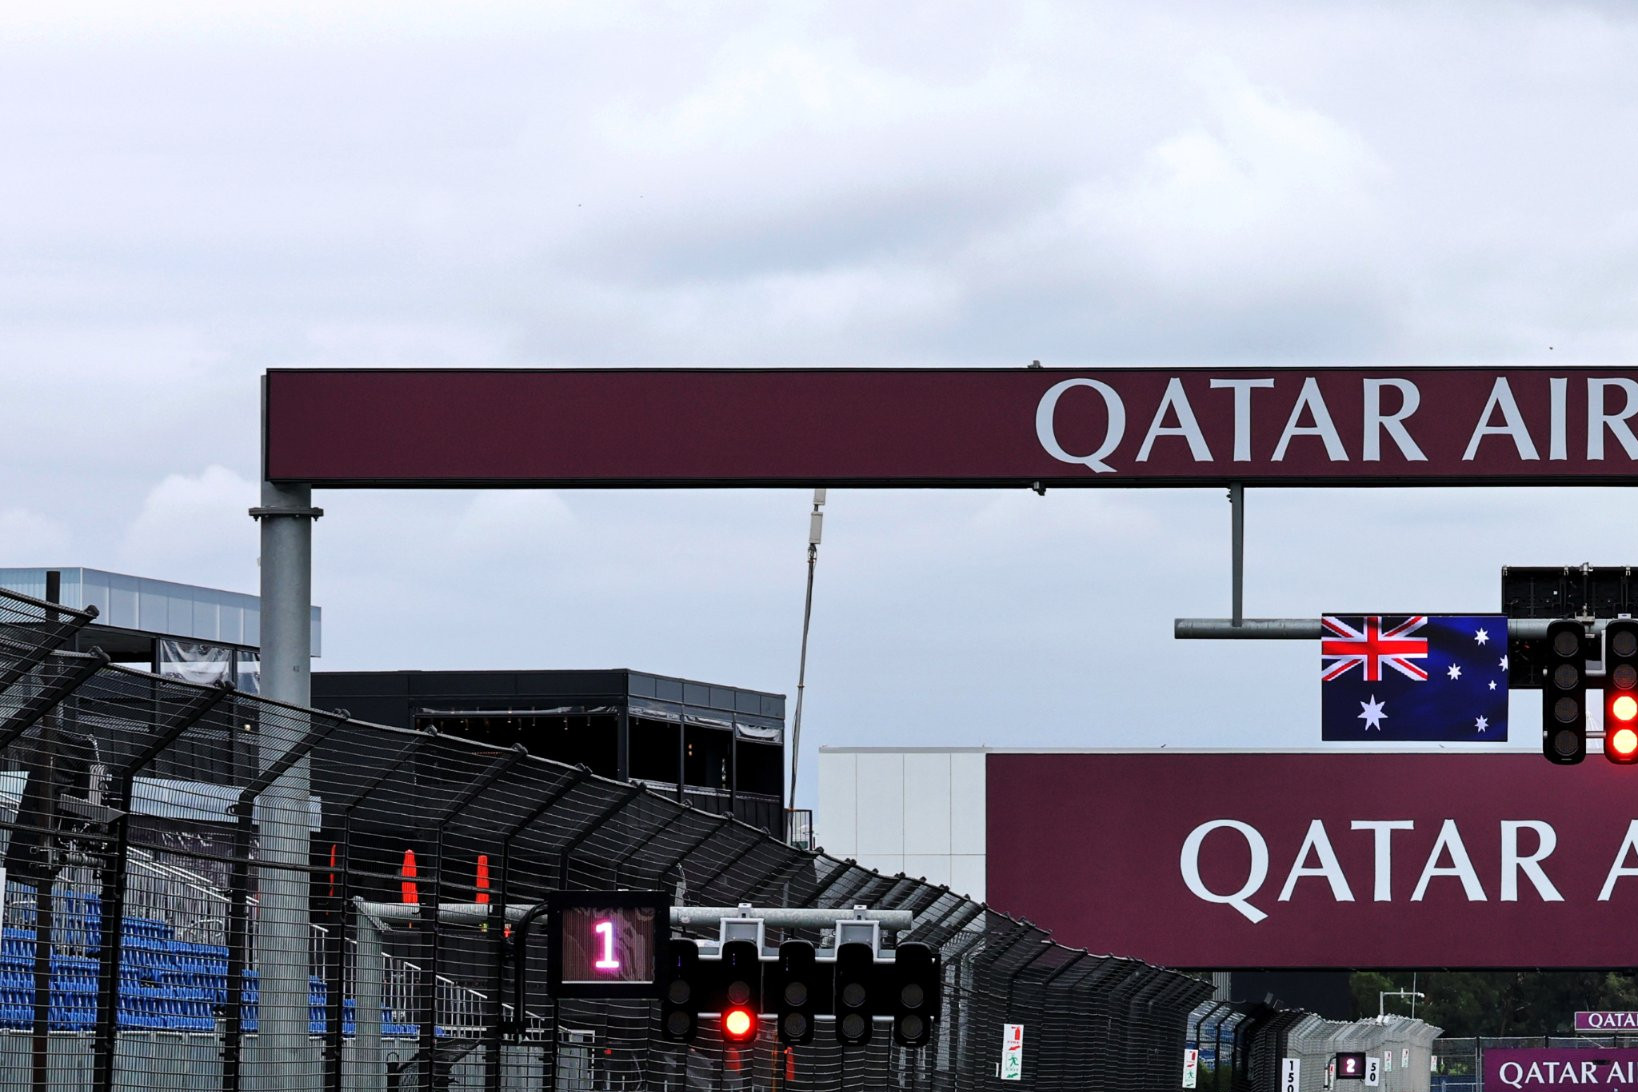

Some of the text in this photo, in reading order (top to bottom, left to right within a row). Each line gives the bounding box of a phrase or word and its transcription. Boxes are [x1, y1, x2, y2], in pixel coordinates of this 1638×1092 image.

[1036, 377, 1429, 474] QATAR
[1181, 819, 1565, 924] QATAR
[596, 922, 620, 969] 1
[1346, 1058, 1356, 1073] 2
[1499, 1061, 1602, 1090] QATAR
